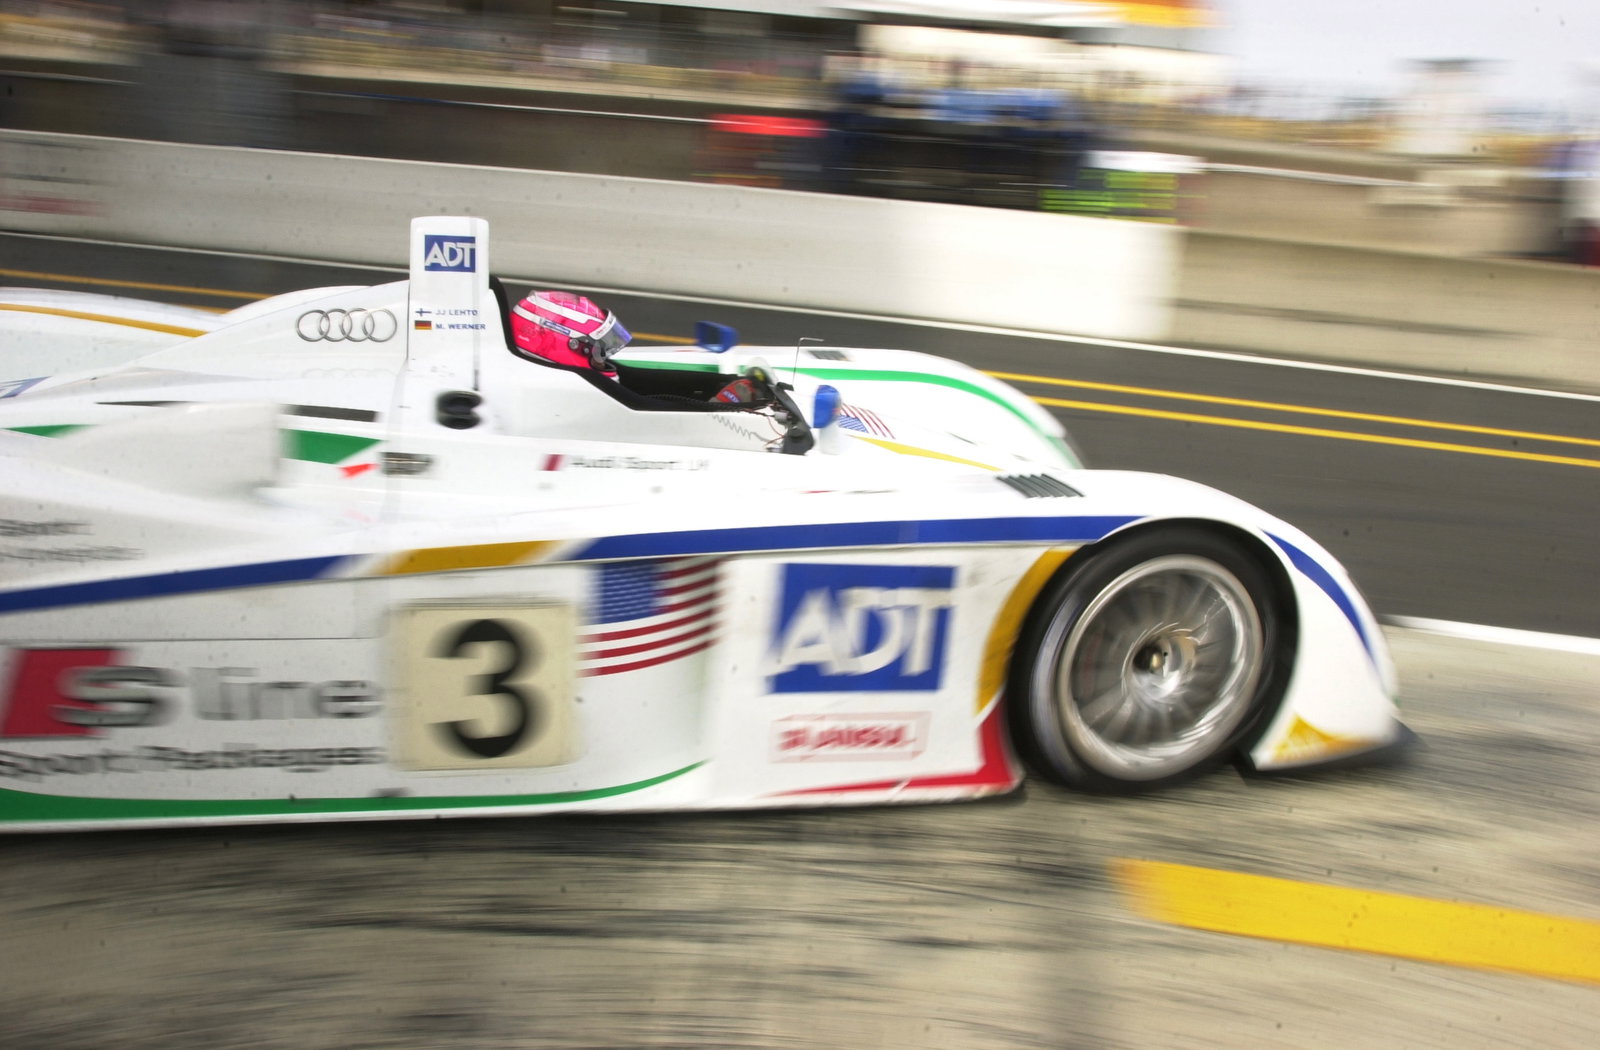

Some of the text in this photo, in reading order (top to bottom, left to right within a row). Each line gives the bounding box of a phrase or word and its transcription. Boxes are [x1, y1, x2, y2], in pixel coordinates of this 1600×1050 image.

[424, 241, 476, 268] ADT
[570, 455, 618, 469] Audi
[624, 456, 682, 472] Sport
[762, 586, 958, 677] ADT
[192, 666, 384, 721] line
[424, 618, 548, 758] 3
